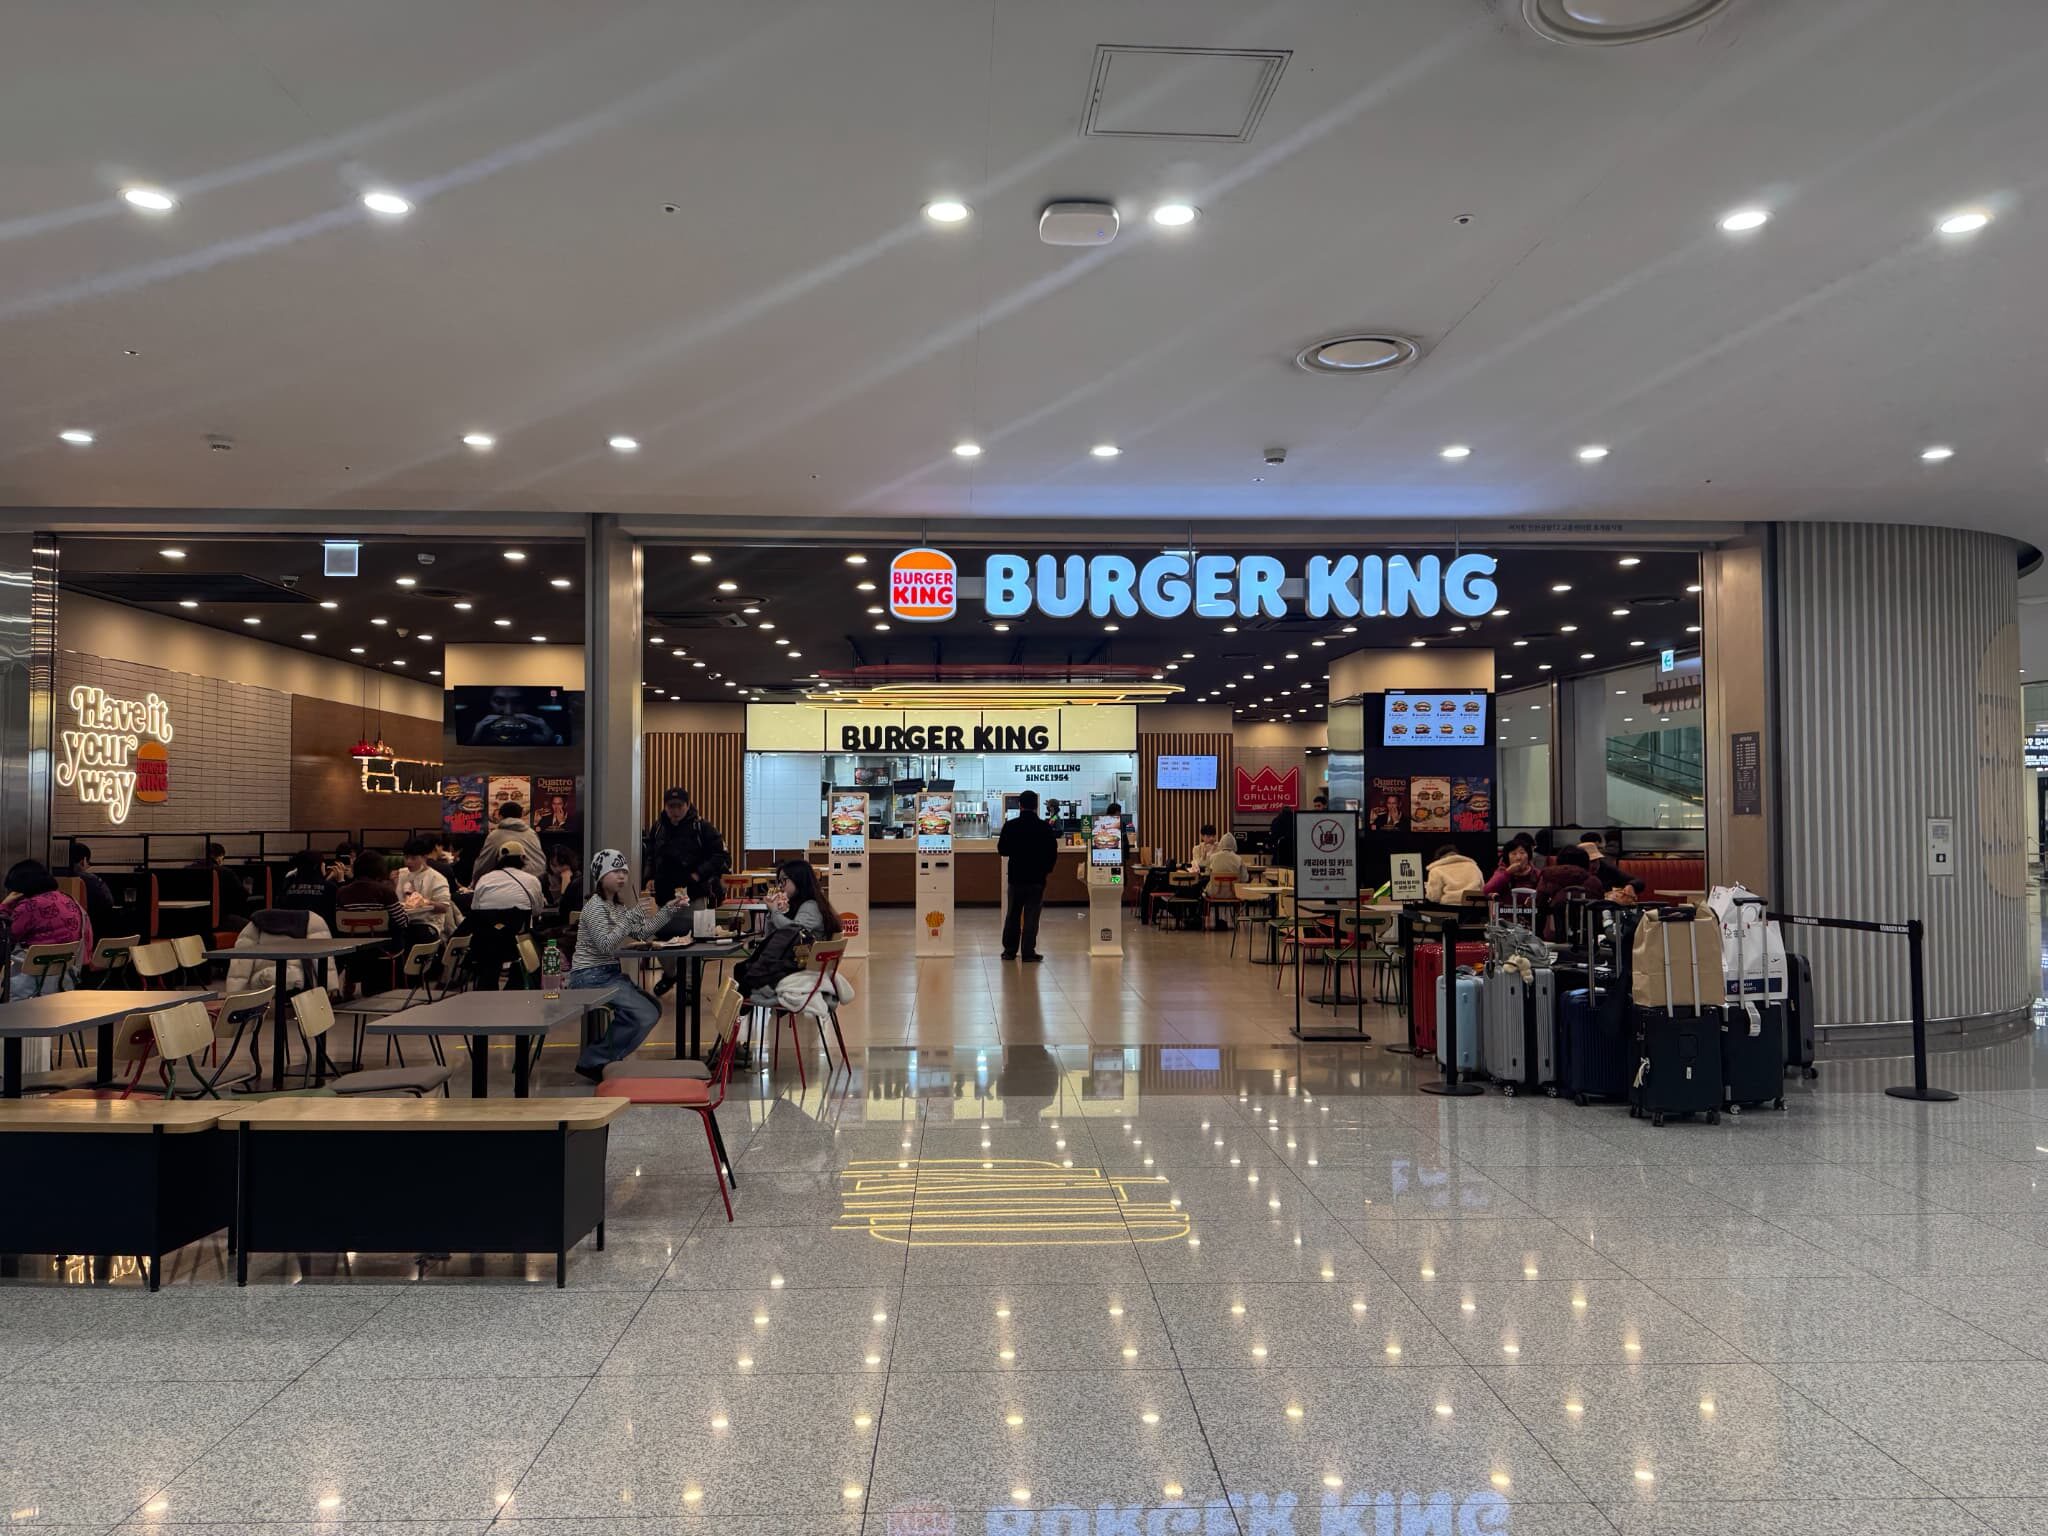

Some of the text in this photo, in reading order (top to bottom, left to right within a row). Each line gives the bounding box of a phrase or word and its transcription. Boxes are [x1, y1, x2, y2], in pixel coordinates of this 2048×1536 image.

[893, 571, 953, 585] BURGER
[985, 553, 1498, 619] BURGER KING
[893, 586, 953, 605] KING
[70, 685, 173, 743] Have it
[841, 725, 1050, 750] BURGER KING
[57, 731, 138, 786] your
[1014, 764, 1081, 772] FLAME GRILLING
[136, 774, 168, 792] KING
[537, 777, 573, 789] Quattro
[1025, 773, 1069, 782] SINCE 1954
[546, 784, 573, 793] Pepper
[1250, 784, 1284, 792] FLAME
[78, 770, 137, 824] way
[1243, 793, 1291, 801] GRILLING
[1303, 858, 1353, 867] 캐리어 및 카트
[1311, 867, 1344, 876] 반입 금지
